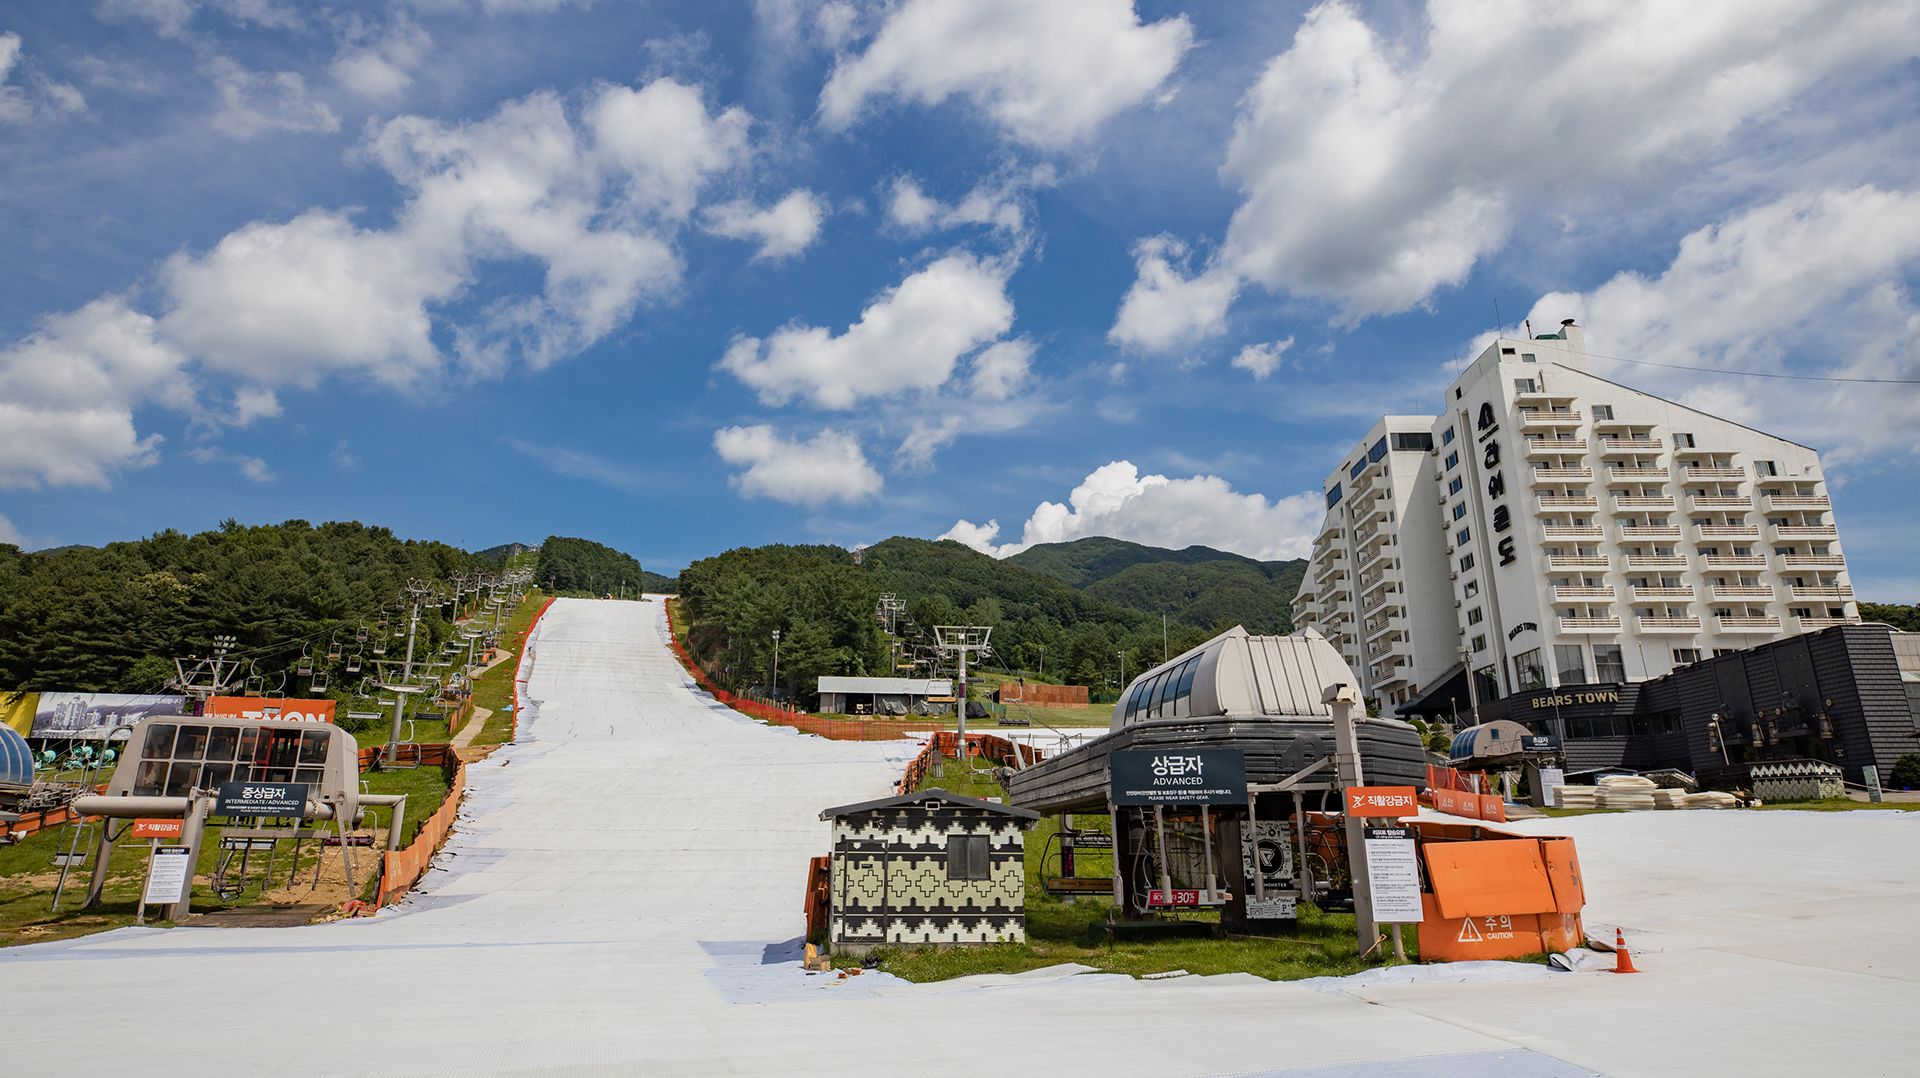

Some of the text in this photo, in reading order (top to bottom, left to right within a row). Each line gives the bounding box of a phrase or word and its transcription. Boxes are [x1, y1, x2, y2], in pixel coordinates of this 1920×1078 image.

[1532, 691, 1619, 709] BEARS TOWN
[1151, 755, 1203, 776] 상급자
[1153, 777, 1203, 786] ADVANCED
[242, 787, 286, 799] 중상급자
[1367, 795, 1413, 807] 직활강금지
[1485, 915, 1512, 931] 주의
[1486, 932, 1513, 940] CAUTION
